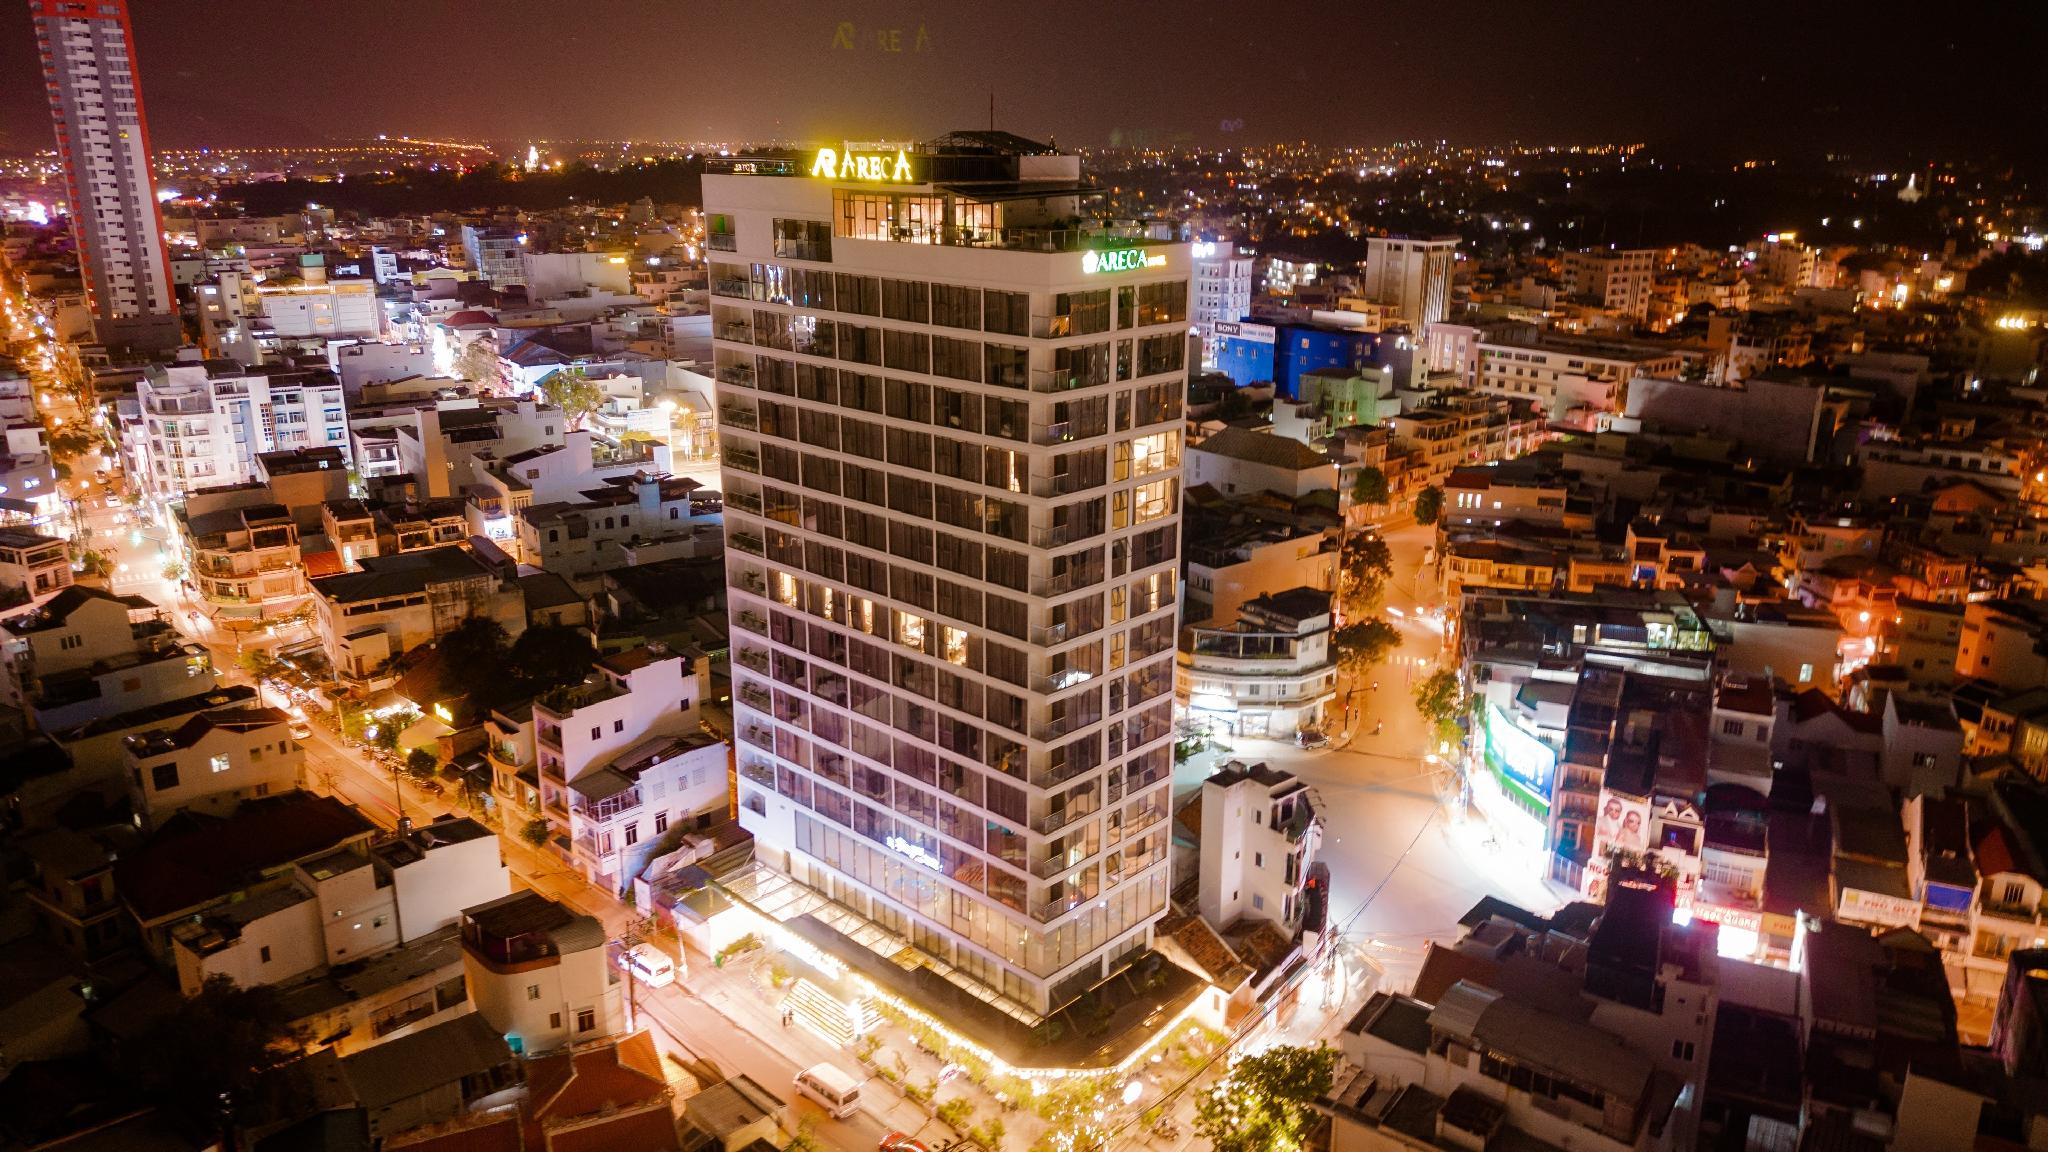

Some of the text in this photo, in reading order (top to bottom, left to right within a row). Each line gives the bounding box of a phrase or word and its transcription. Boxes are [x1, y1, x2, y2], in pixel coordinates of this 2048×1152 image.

[839, 145, 913, 180] ARECA
[1097, 249, 1148, 272] ARECA
[1217, 322, 1239, 333] SONY
